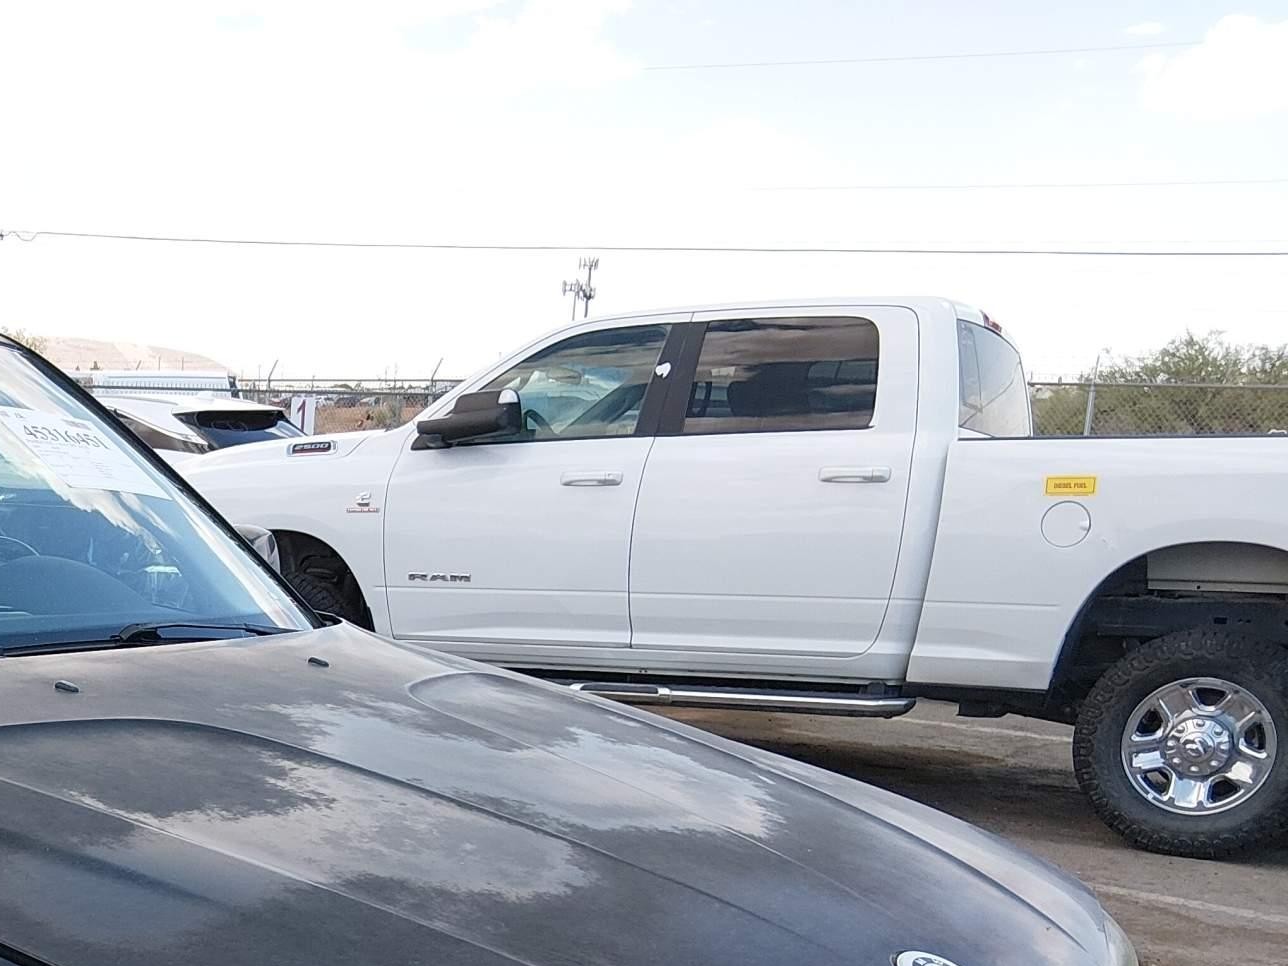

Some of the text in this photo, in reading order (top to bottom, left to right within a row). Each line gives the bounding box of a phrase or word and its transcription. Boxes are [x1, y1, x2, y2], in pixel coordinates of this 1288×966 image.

[297, 399, 307, 432] 1
[23, 424, 111, 450] 45316451
[294, 442, 329, 451] 2500
[408, 571, 471, 582] RAM
